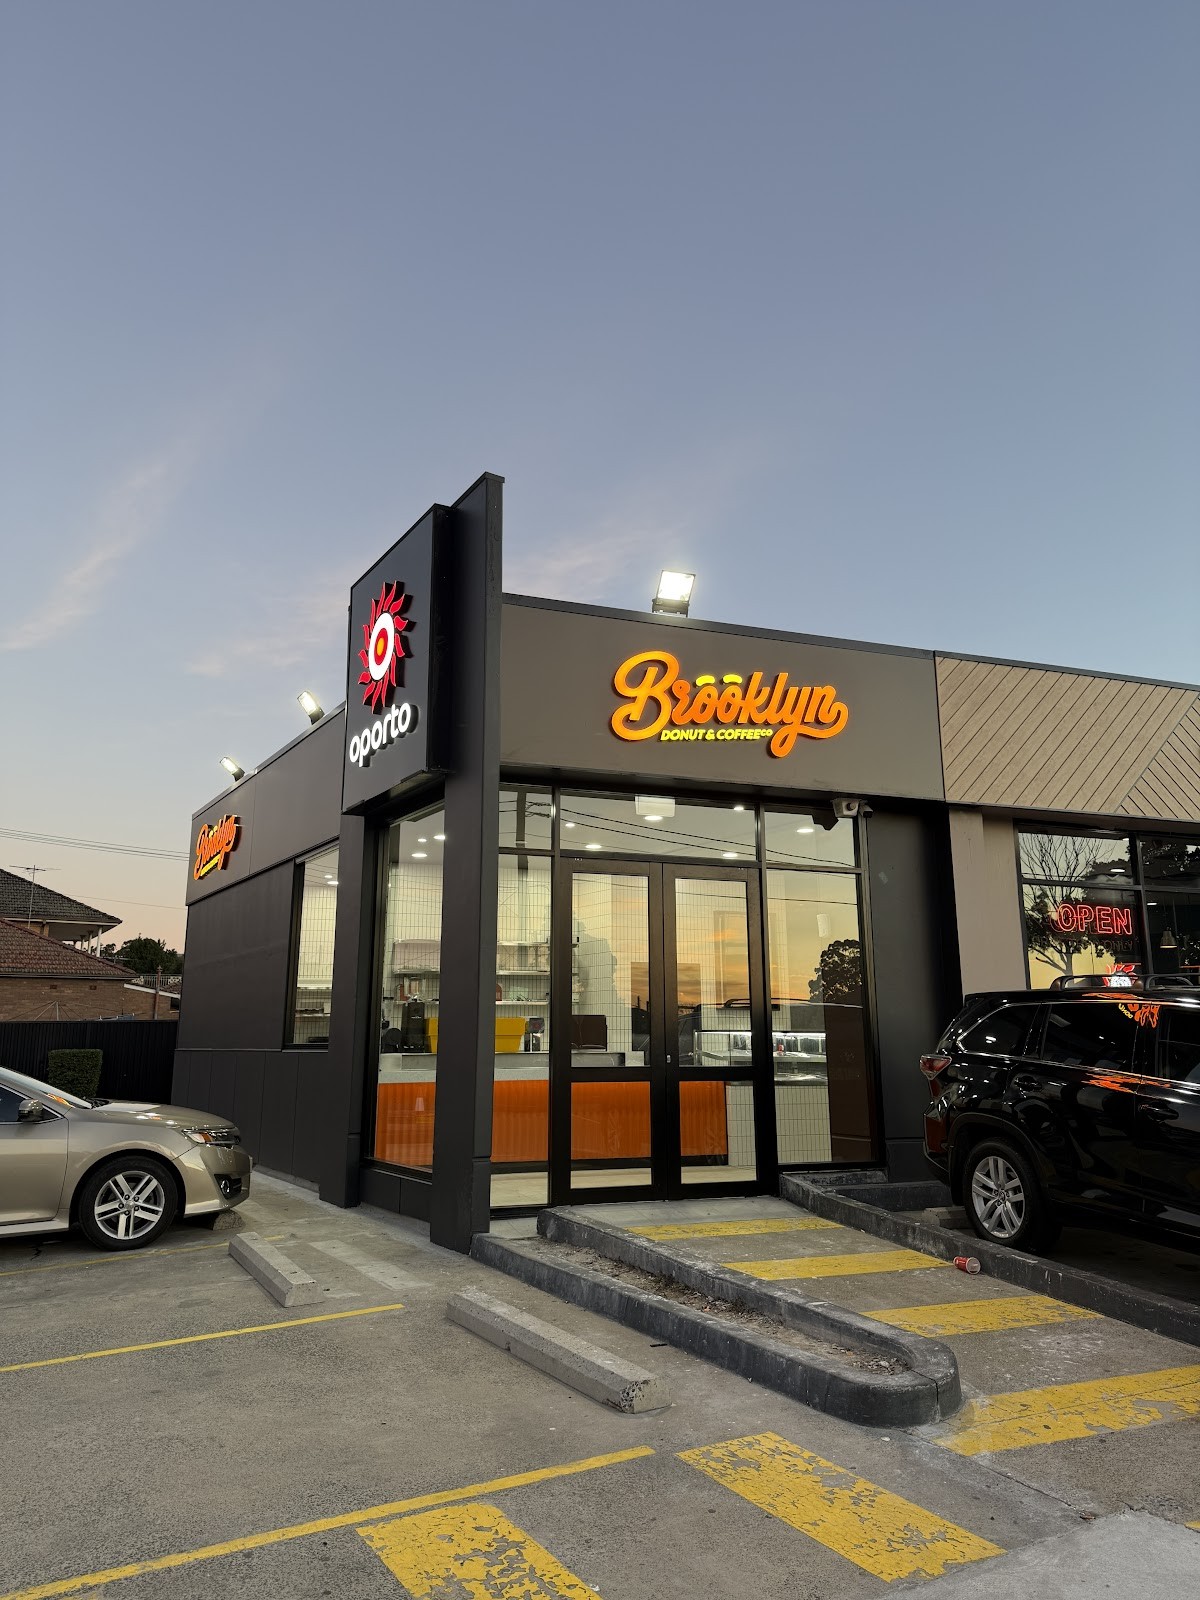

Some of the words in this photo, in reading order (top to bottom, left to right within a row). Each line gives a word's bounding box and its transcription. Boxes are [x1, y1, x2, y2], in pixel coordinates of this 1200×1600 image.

[611, 650, 849, 758] Brooklyn
[349, 702, 412, 768] oporto
[660, 729, 706, 741] DONUT
[705, 729, 716, 740] &
[1057, 903, 1133, 935] OPEN
